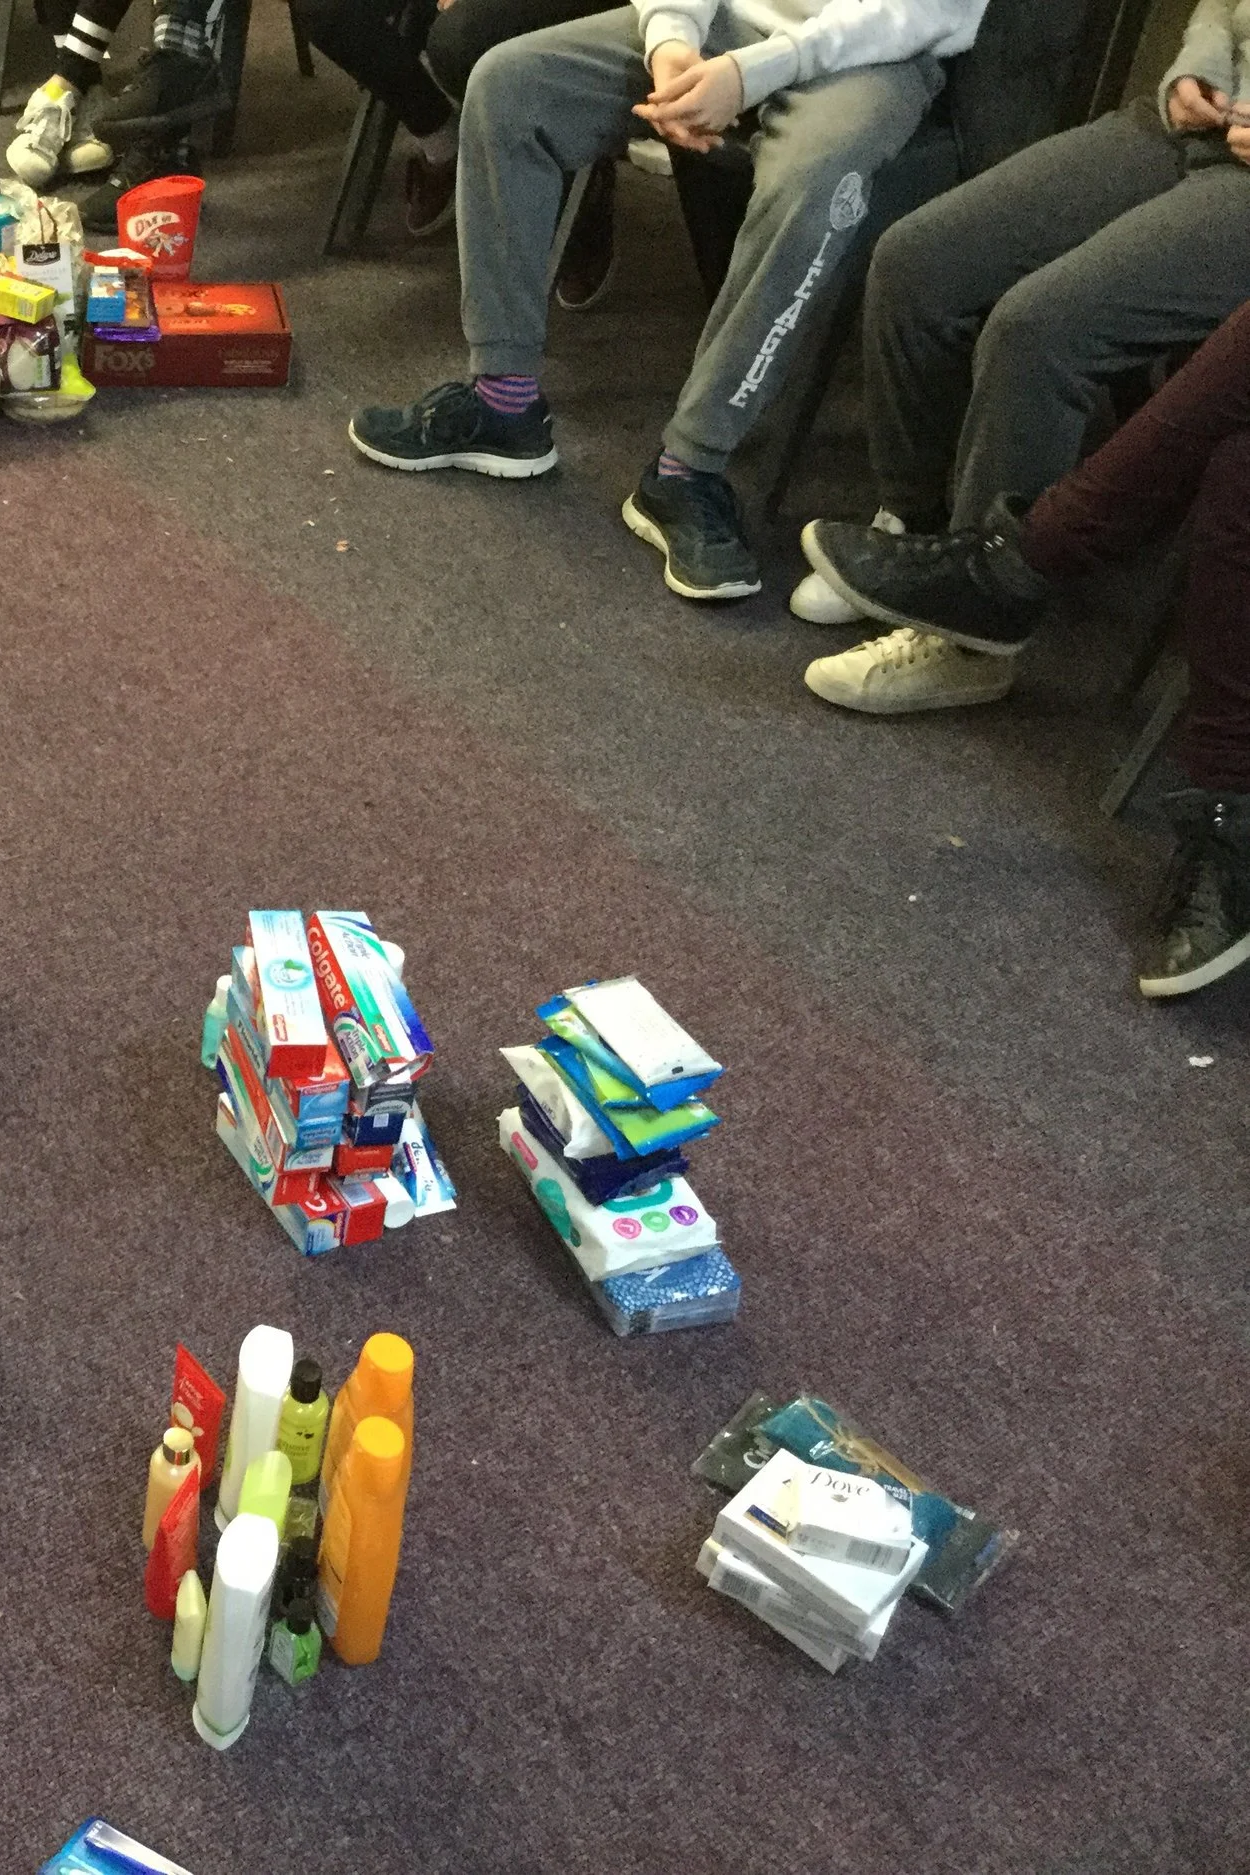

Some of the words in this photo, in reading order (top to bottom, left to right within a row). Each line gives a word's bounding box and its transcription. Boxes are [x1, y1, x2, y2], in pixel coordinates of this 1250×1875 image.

[728, 231, 831, 408] LEAGUE
[307, 927, 347, 1010] Colgate
[344, 1032, 360, 1059] Action
[351, 1030, 366, 1053] Triple
[809, 1471, 870, 1496] Dove
[884, 1484, 908, 1495] TRAVEL
